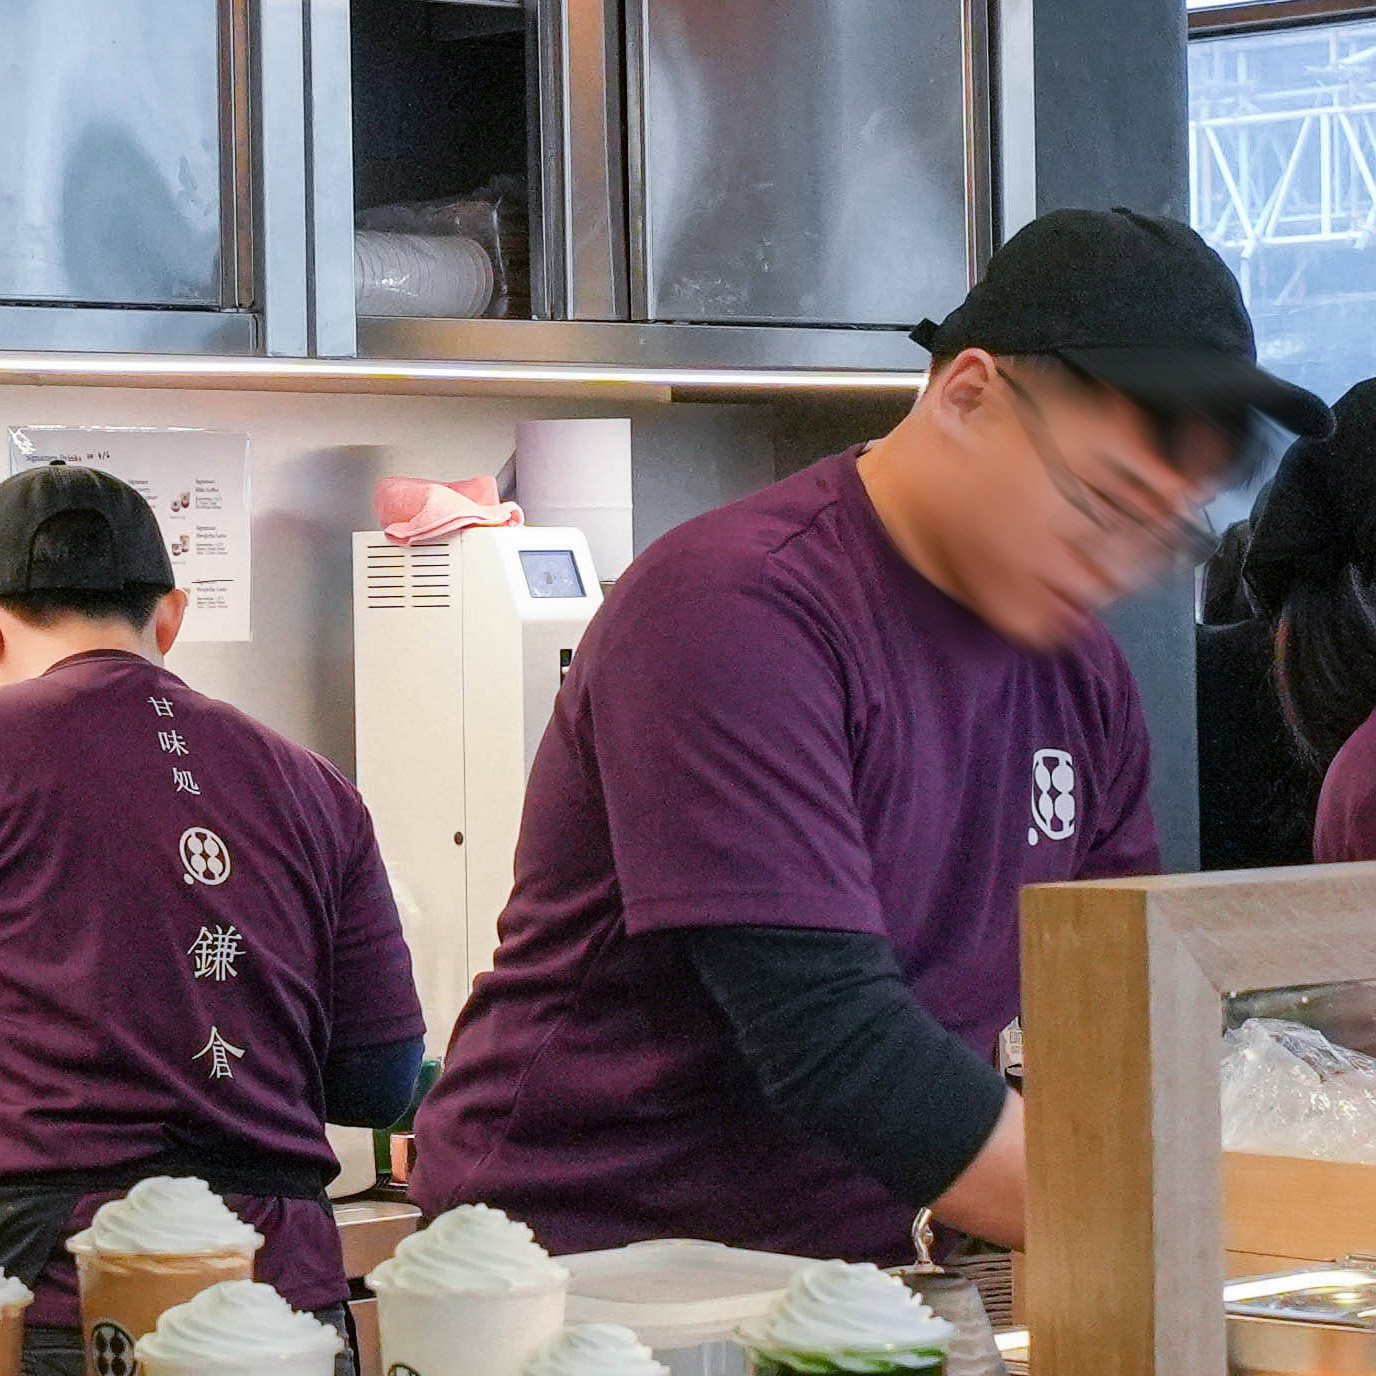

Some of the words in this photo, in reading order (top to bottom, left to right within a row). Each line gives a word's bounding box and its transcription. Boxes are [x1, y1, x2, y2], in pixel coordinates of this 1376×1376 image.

[147, 696, 201, 796] 甘味処
[187, 924, 246, 1079] 鎌倉
